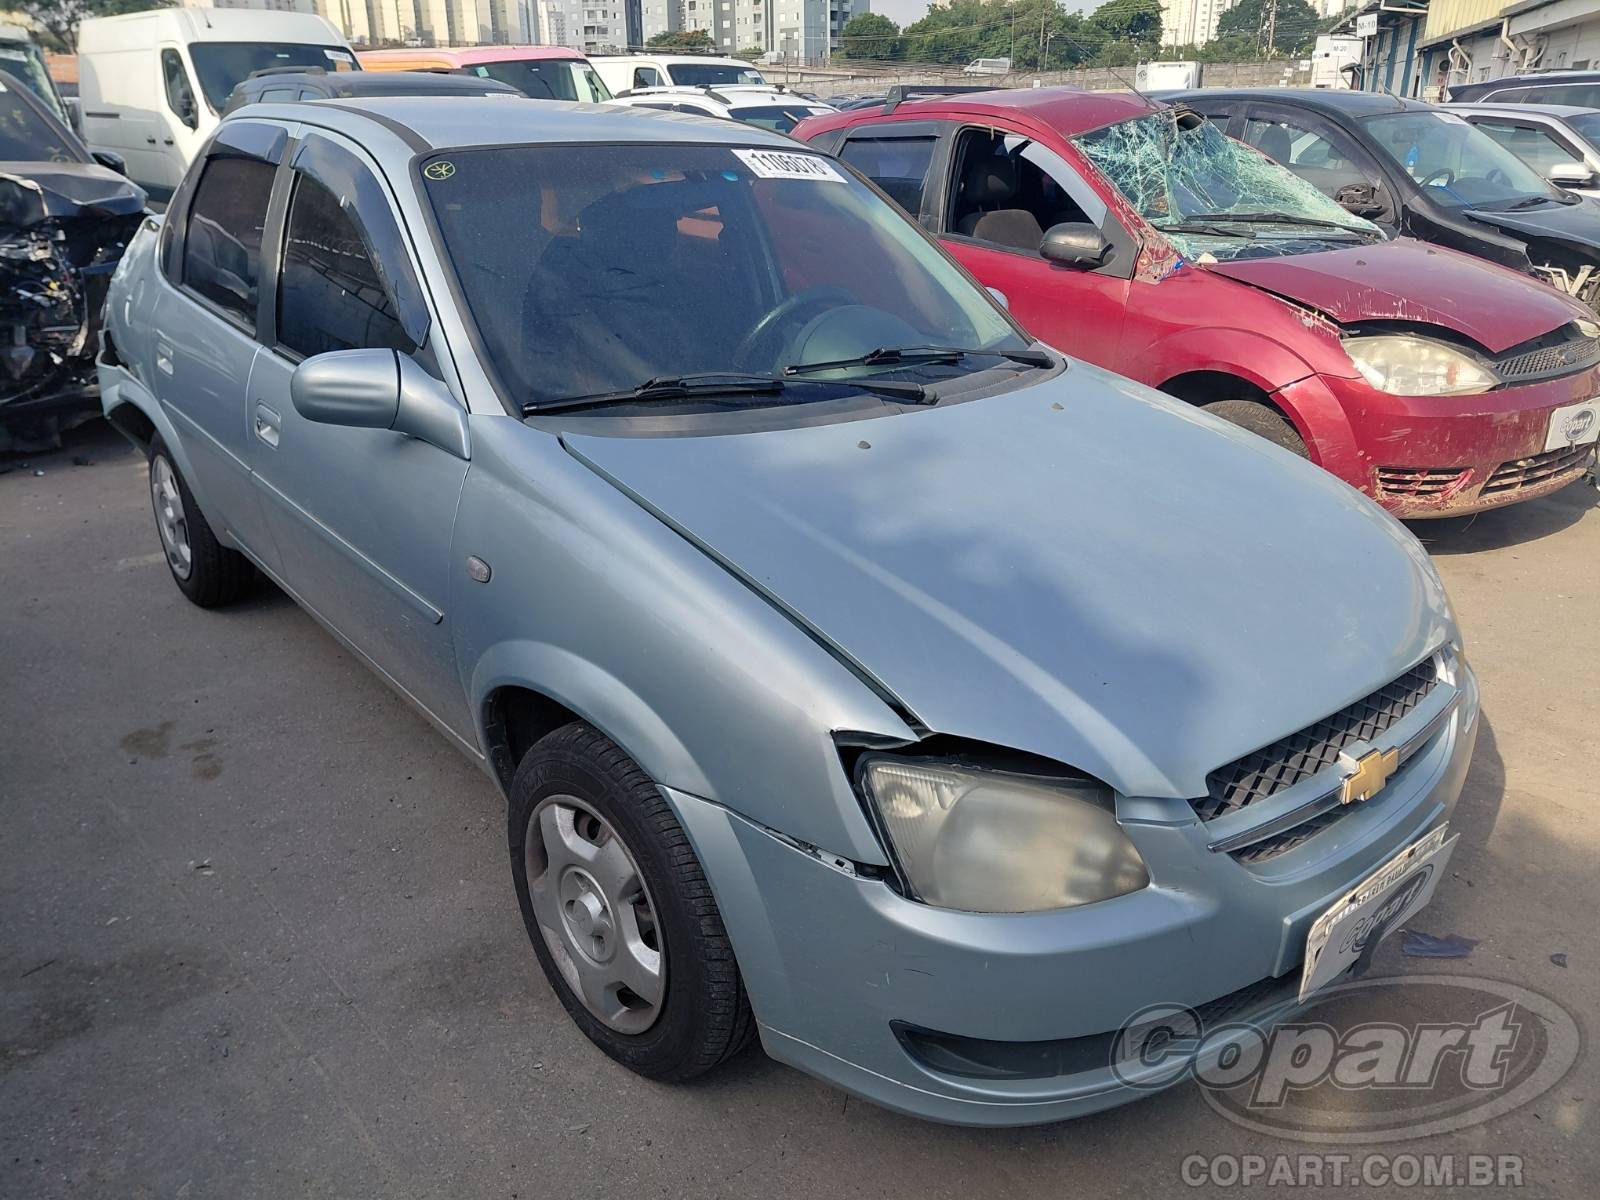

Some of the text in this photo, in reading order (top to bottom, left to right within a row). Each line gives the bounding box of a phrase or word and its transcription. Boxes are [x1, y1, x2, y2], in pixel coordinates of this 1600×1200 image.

[1358, 20, 1375, 30] M-10
[750, 152, 828, 176] 1106078
[1339, 876, 1422, 954] Copart
